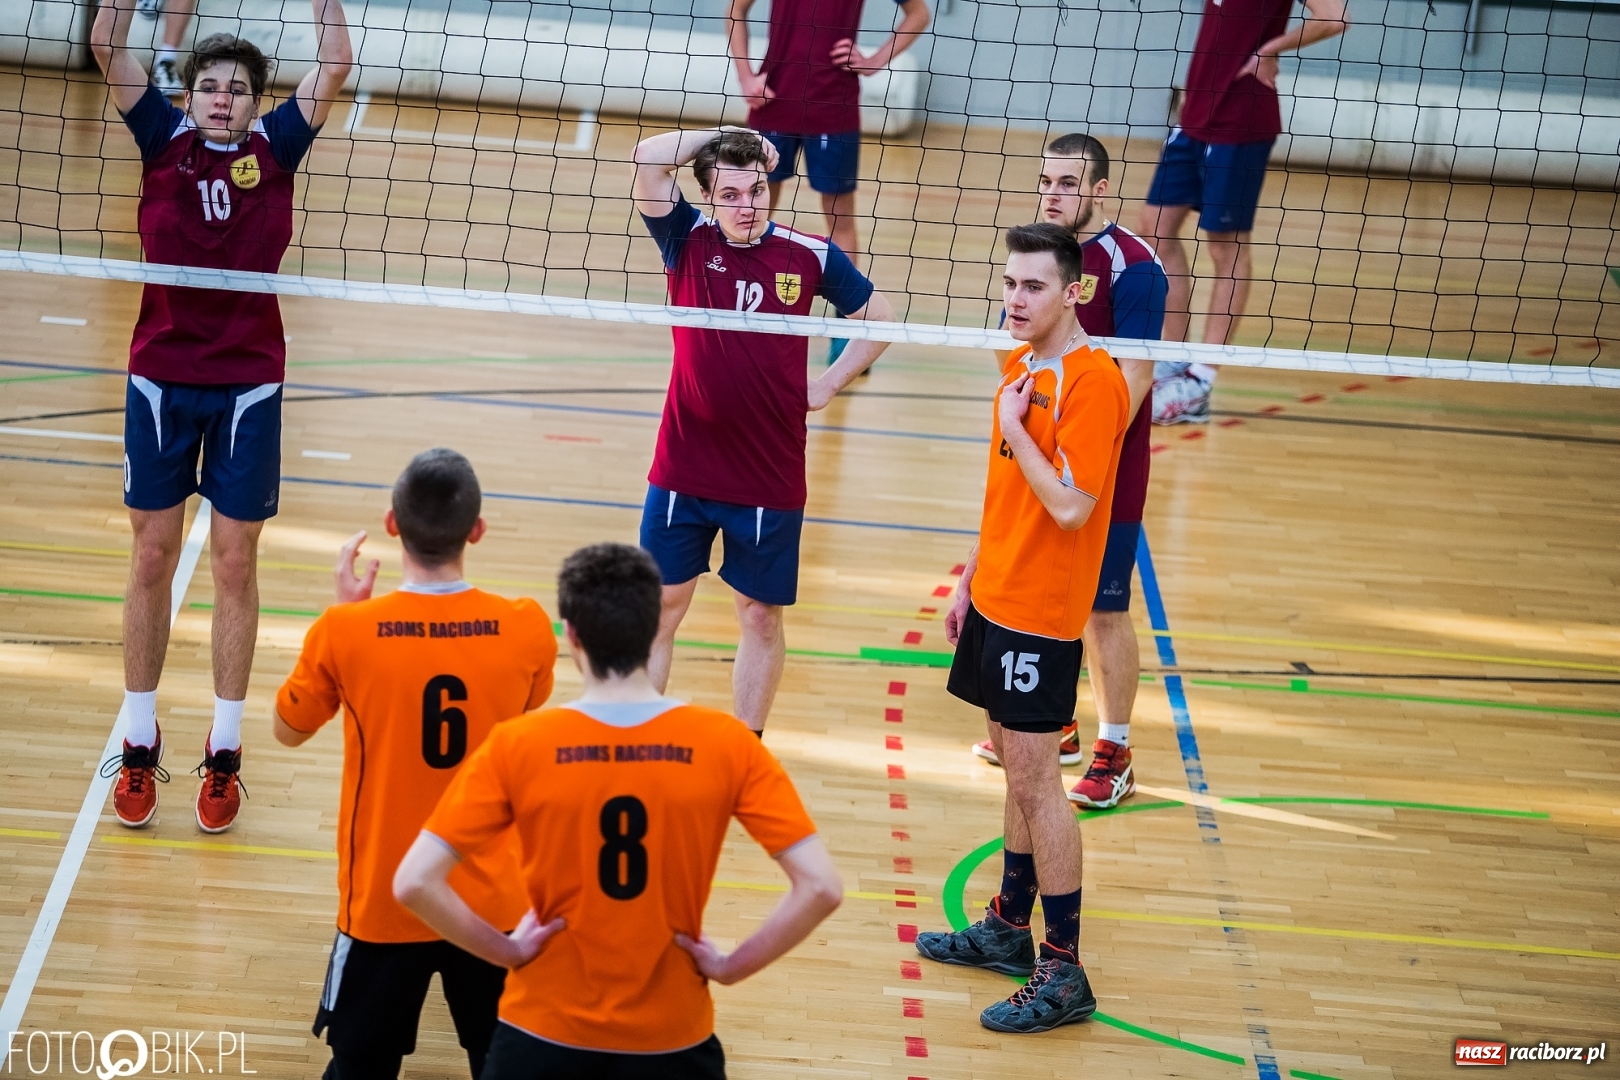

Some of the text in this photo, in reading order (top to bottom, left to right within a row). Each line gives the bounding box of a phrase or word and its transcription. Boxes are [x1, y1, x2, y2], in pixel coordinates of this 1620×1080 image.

[198, 178, 231, 222] 10
[735, 280, 764, 312] 12
[377, 618, 500, 638] ZSOMS RACIBÓRZ
[1000, 651, 1041, 693] 15
[421, 674, 468, 769] 6
[598, 794, 648, 901] 8
